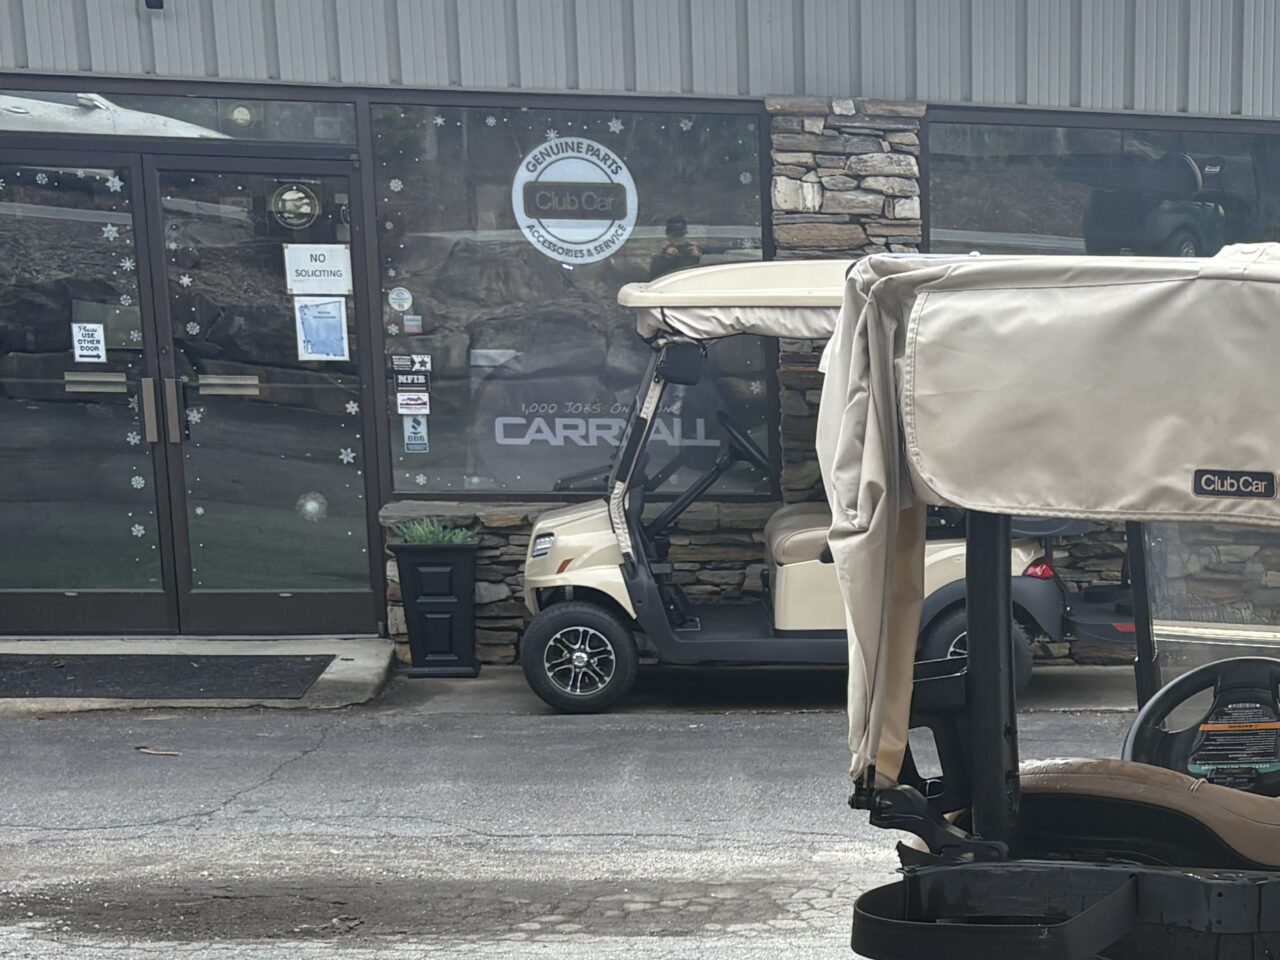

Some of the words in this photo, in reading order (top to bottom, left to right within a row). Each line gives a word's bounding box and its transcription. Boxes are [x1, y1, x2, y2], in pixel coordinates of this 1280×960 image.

[525, 141, 583, 173] GENUINE
[585, 143, 622, 175] PARTS
[535, 190, 579, 210] Club
[582, 191, 615, 211] Car
[525, 223, 585, 259] ACCESSORIES
[586, 248, 595, 257] &
[593, 223, 627, 255] SERVICE
[309, 253, 326, 263] NO
[295, 269, 343, 278] SOLICITING
[397, 375, 426, 384] NFIB
[521, 402, 558, 415] 1,000
[494, 416, 720, 446] CARRALL
[1201, 475, 1238, 492] Club
[1239, 476, 1268, 493] Car
